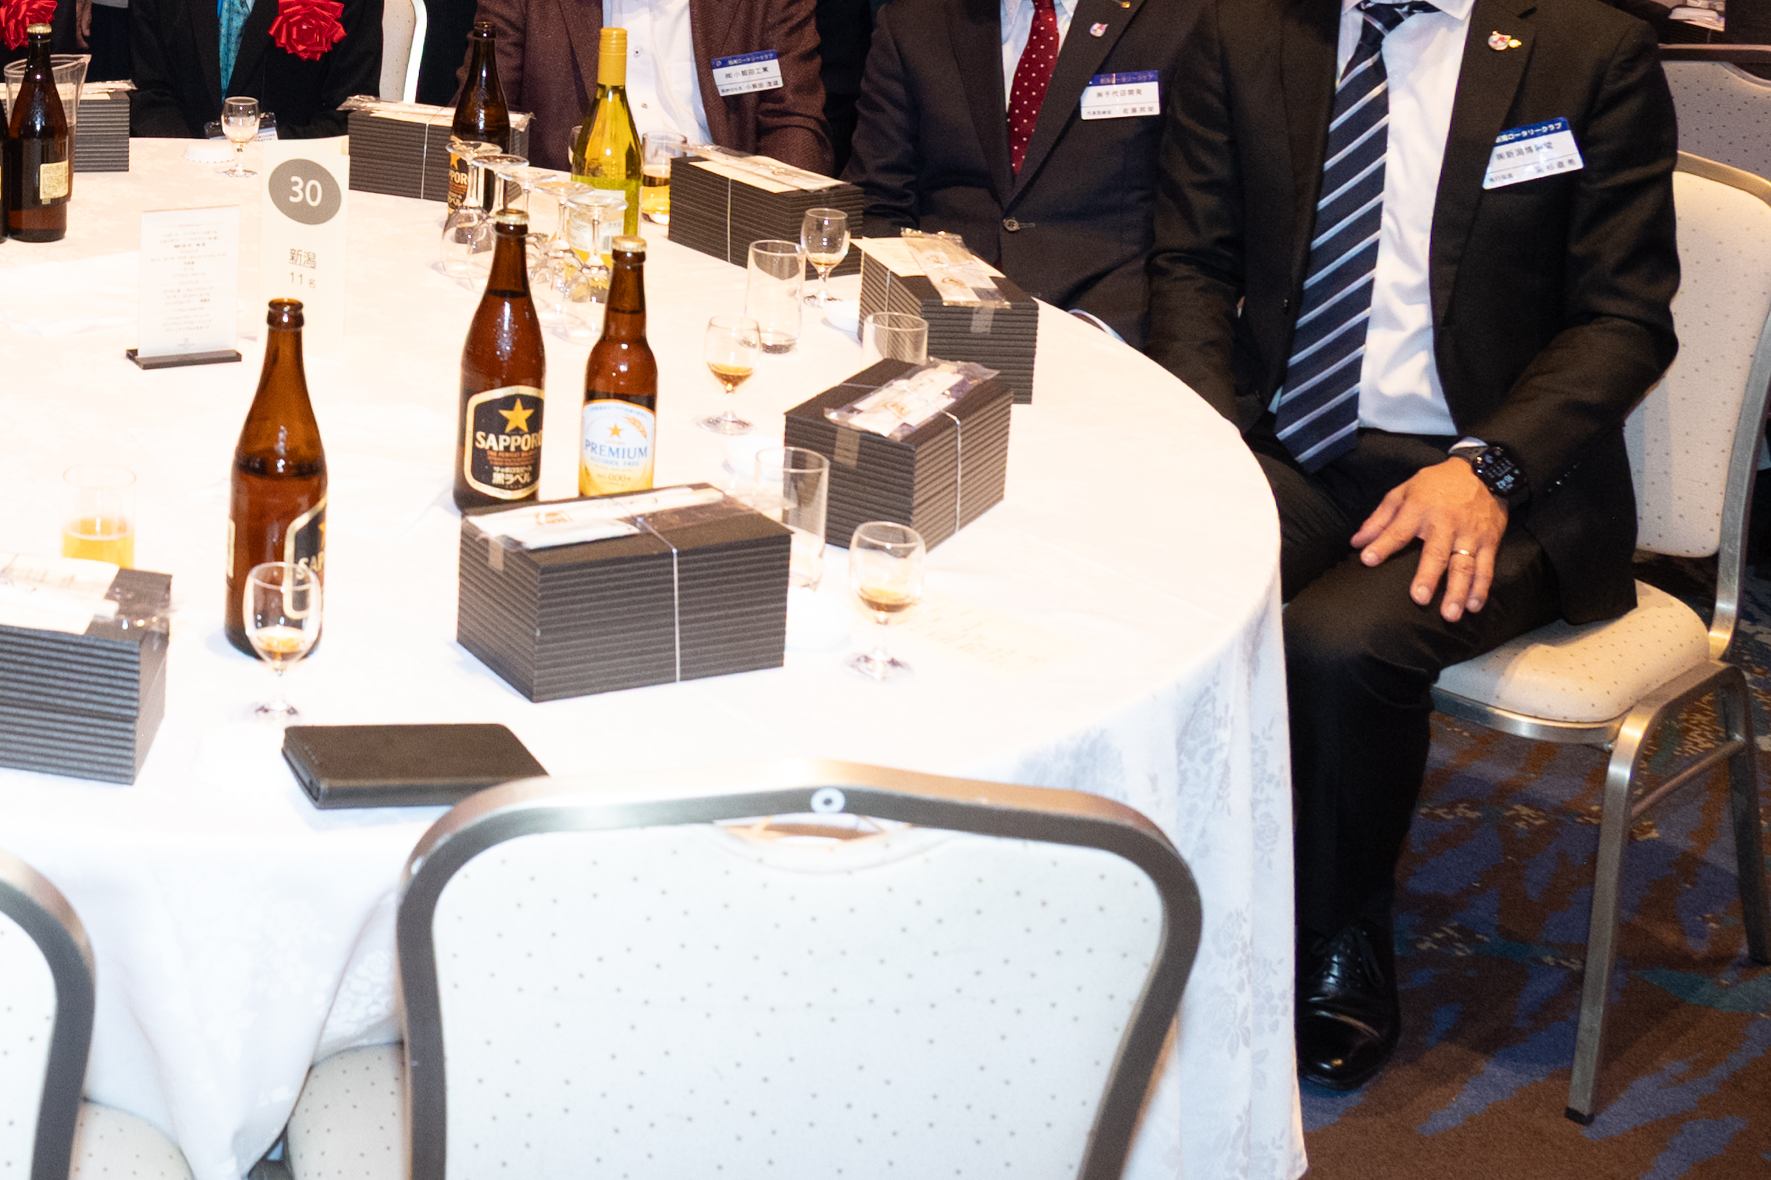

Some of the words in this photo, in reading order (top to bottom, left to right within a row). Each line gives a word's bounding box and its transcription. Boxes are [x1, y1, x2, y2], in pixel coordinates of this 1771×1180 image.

[288, 175, 323, 207] 30
[289, 248, 316, 270] 新潟
[585, 438, 648, 460] PREMIUM
[492, 471, 532, 485] 黒ラベル
